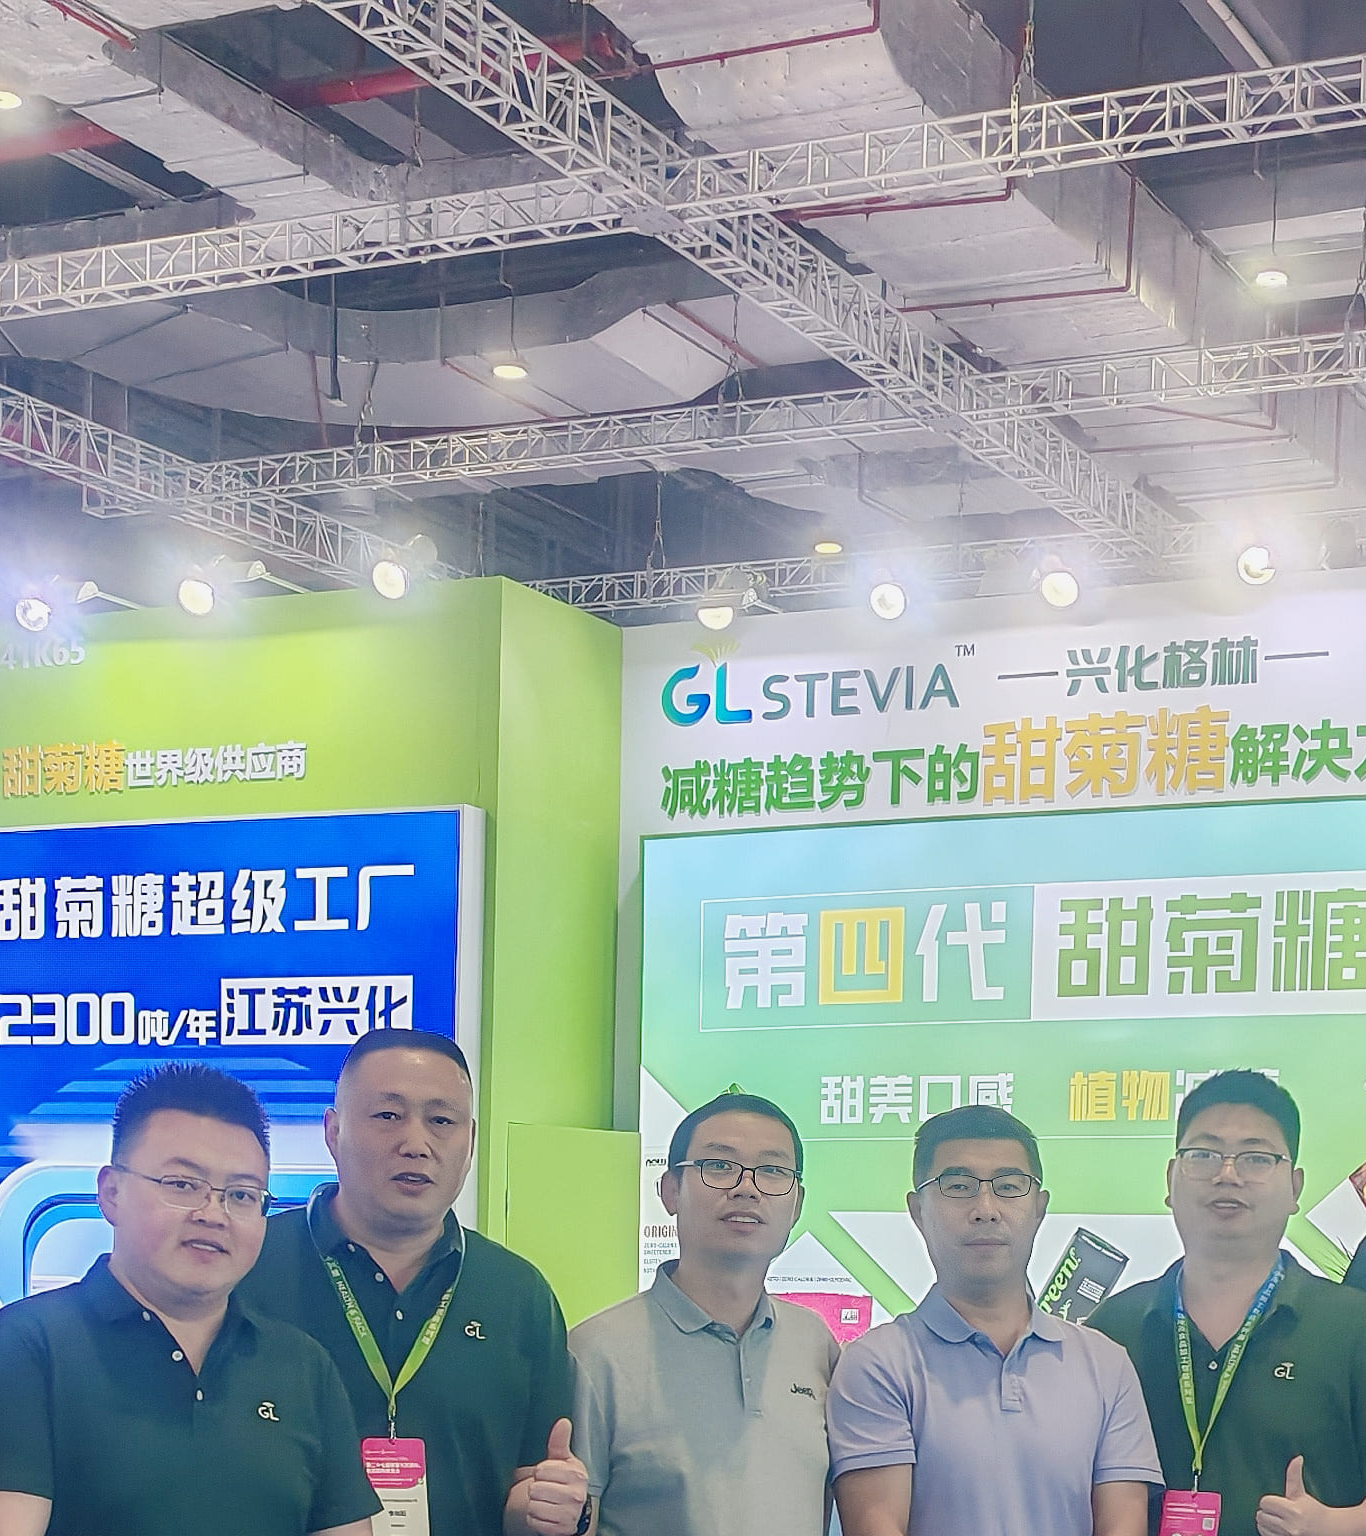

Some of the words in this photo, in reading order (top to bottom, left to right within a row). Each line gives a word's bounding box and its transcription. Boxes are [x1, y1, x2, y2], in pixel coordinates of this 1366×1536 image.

[661, 662, 753, 726] GL
[762, 663, 960, 720] STEVIA
[1066, 636, 1259, 697] 兴化格林
[2, 739, 307, 798] 甜菊糖世界级供应商
[723, 901, 1009, 1010] 第四代
[225, 984, 410, 1036] 江苏兴化
